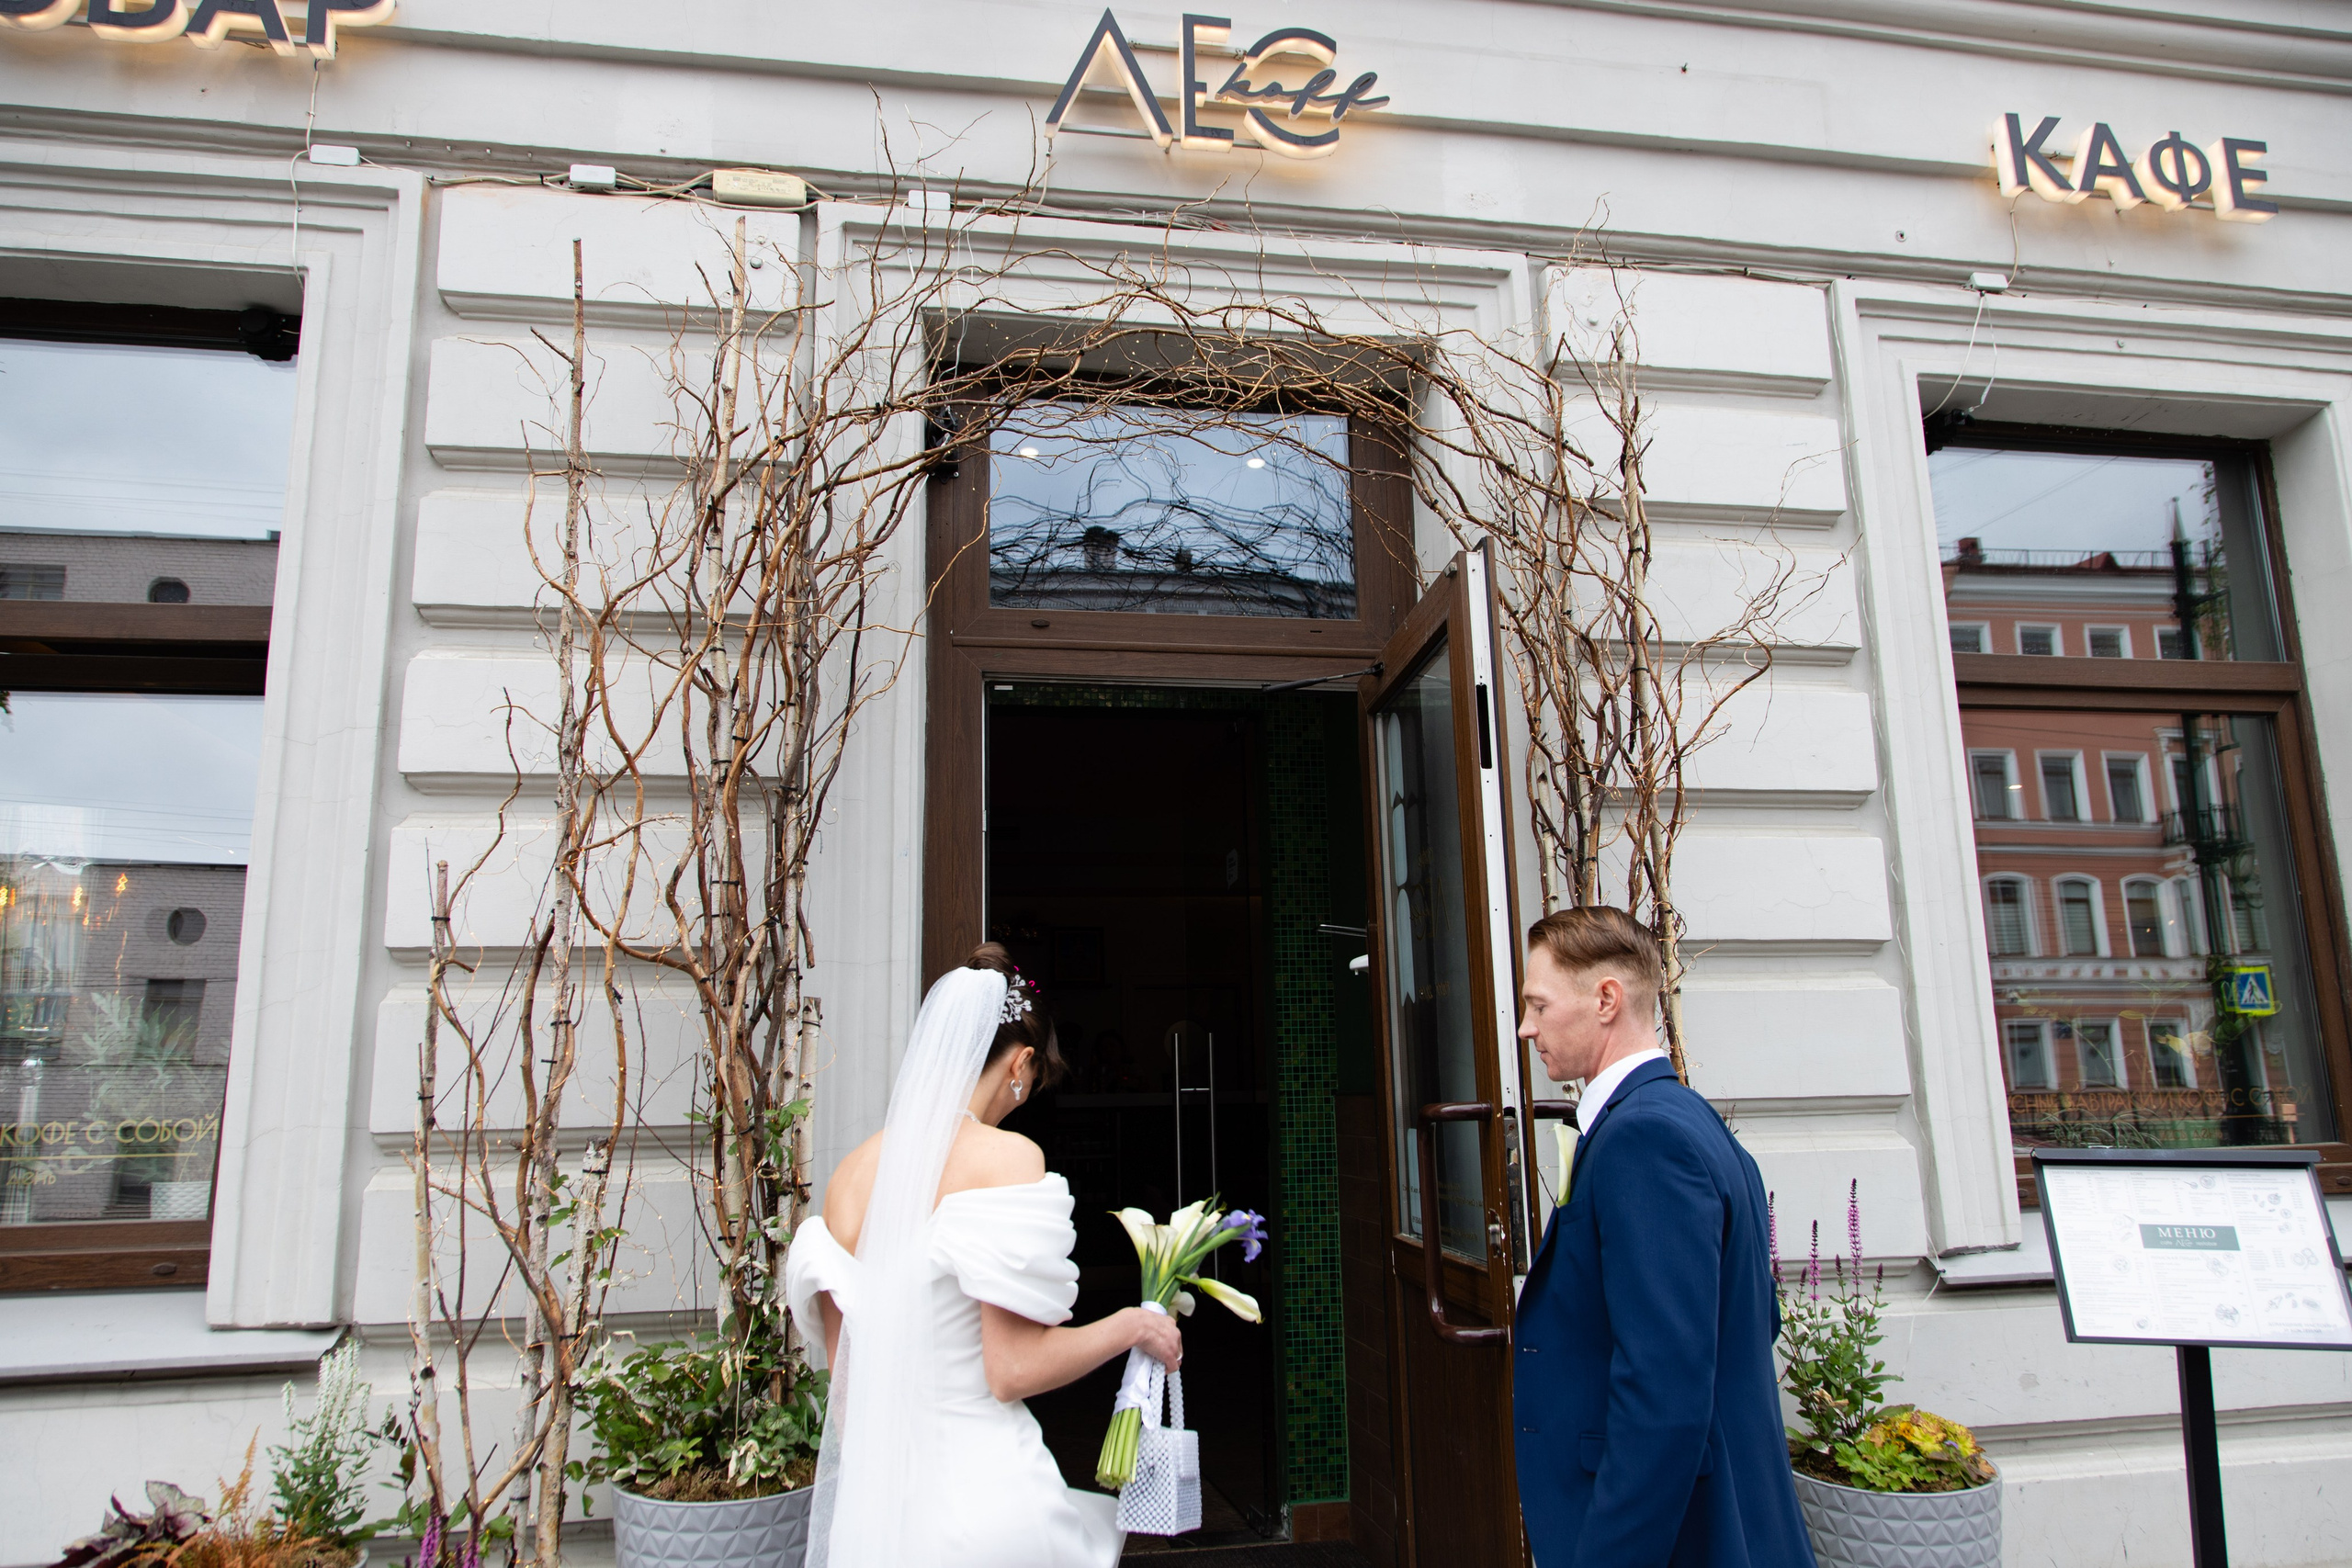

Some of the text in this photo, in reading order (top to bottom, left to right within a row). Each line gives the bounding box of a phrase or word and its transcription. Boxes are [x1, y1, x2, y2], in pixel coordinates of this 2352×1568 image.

[1996, 112, 2278, 220] КАФЕ
[2065, 1091, 2154, 1112] ЗАВТРАКИ
[2158, 1090, 2172, 1109] И
[2177, 1089, 2229, 1108] КОФЕ
[2231, 1088, 2245, 1106] С
[0, 1113, 219, 1146] КОФЕ С СОБОЙ
[6, 1170, 56, 1186] день
[2158, 1226, 2216, 1239] МЕНЮ
